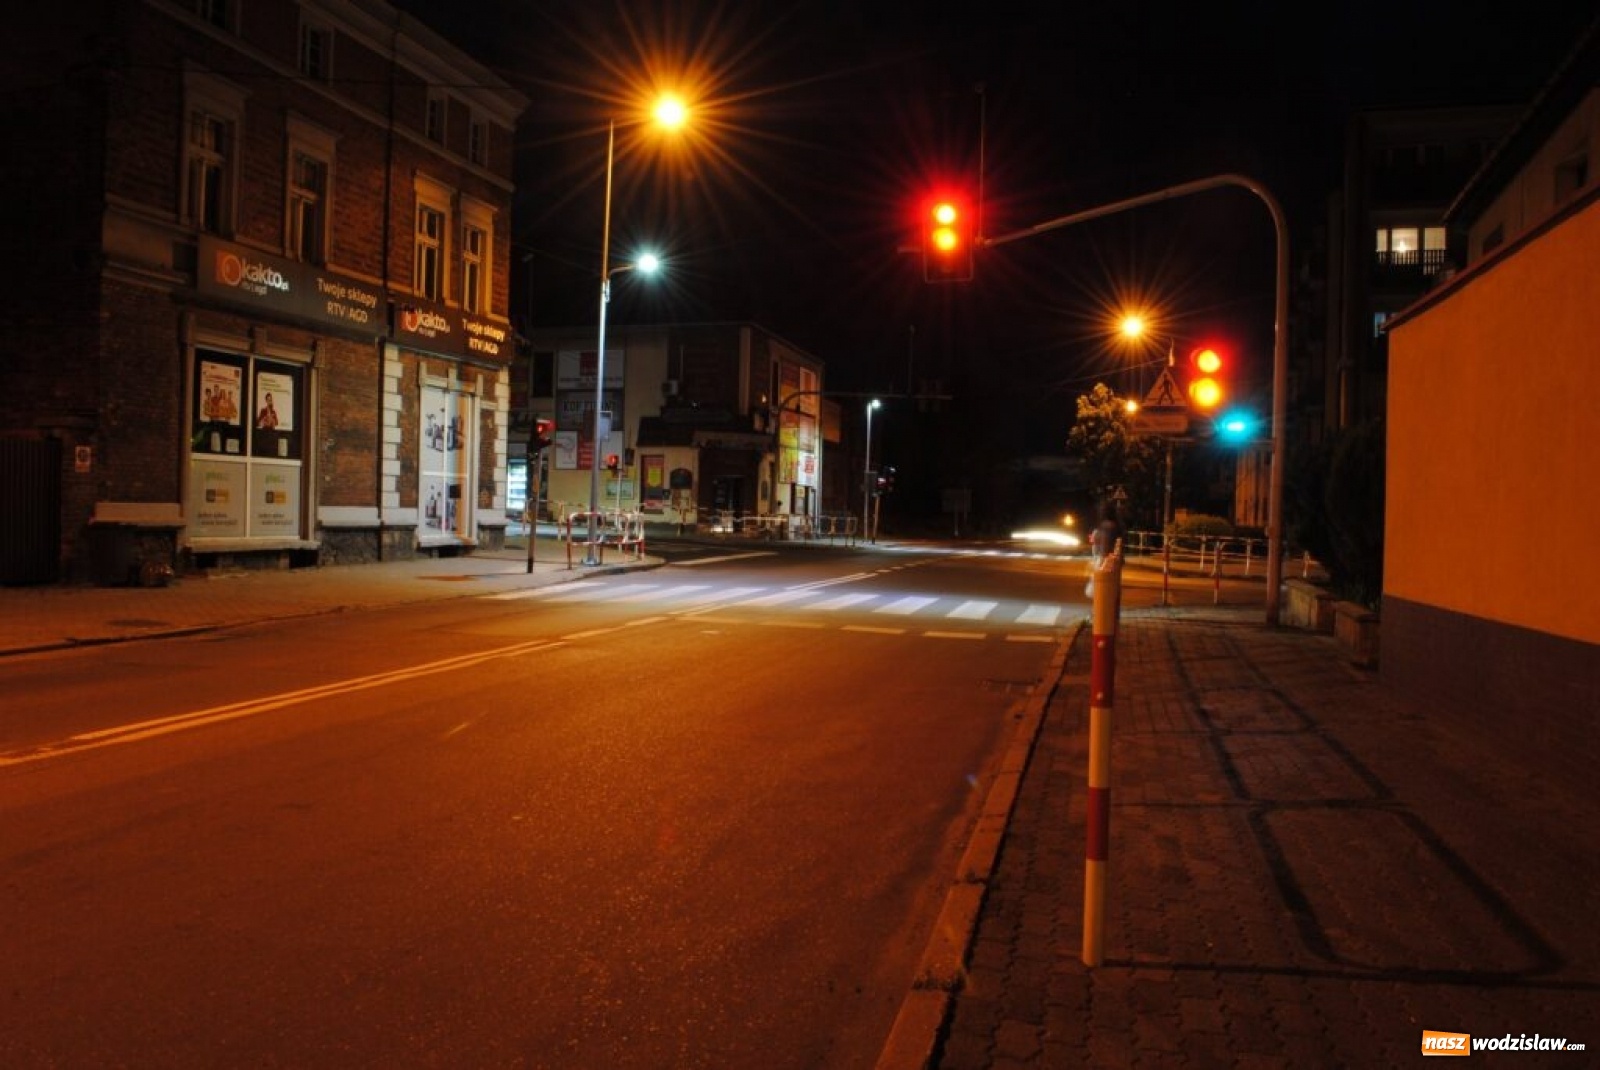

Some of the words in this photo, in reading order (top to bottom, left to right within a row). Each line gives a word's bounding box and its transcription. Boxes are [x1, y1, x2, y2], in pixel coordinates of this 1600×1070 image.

[316, 277, 346, 299] Twoje
[347, 287, 377, 309] sklepy
[327, 300, 347, 318] RTV
